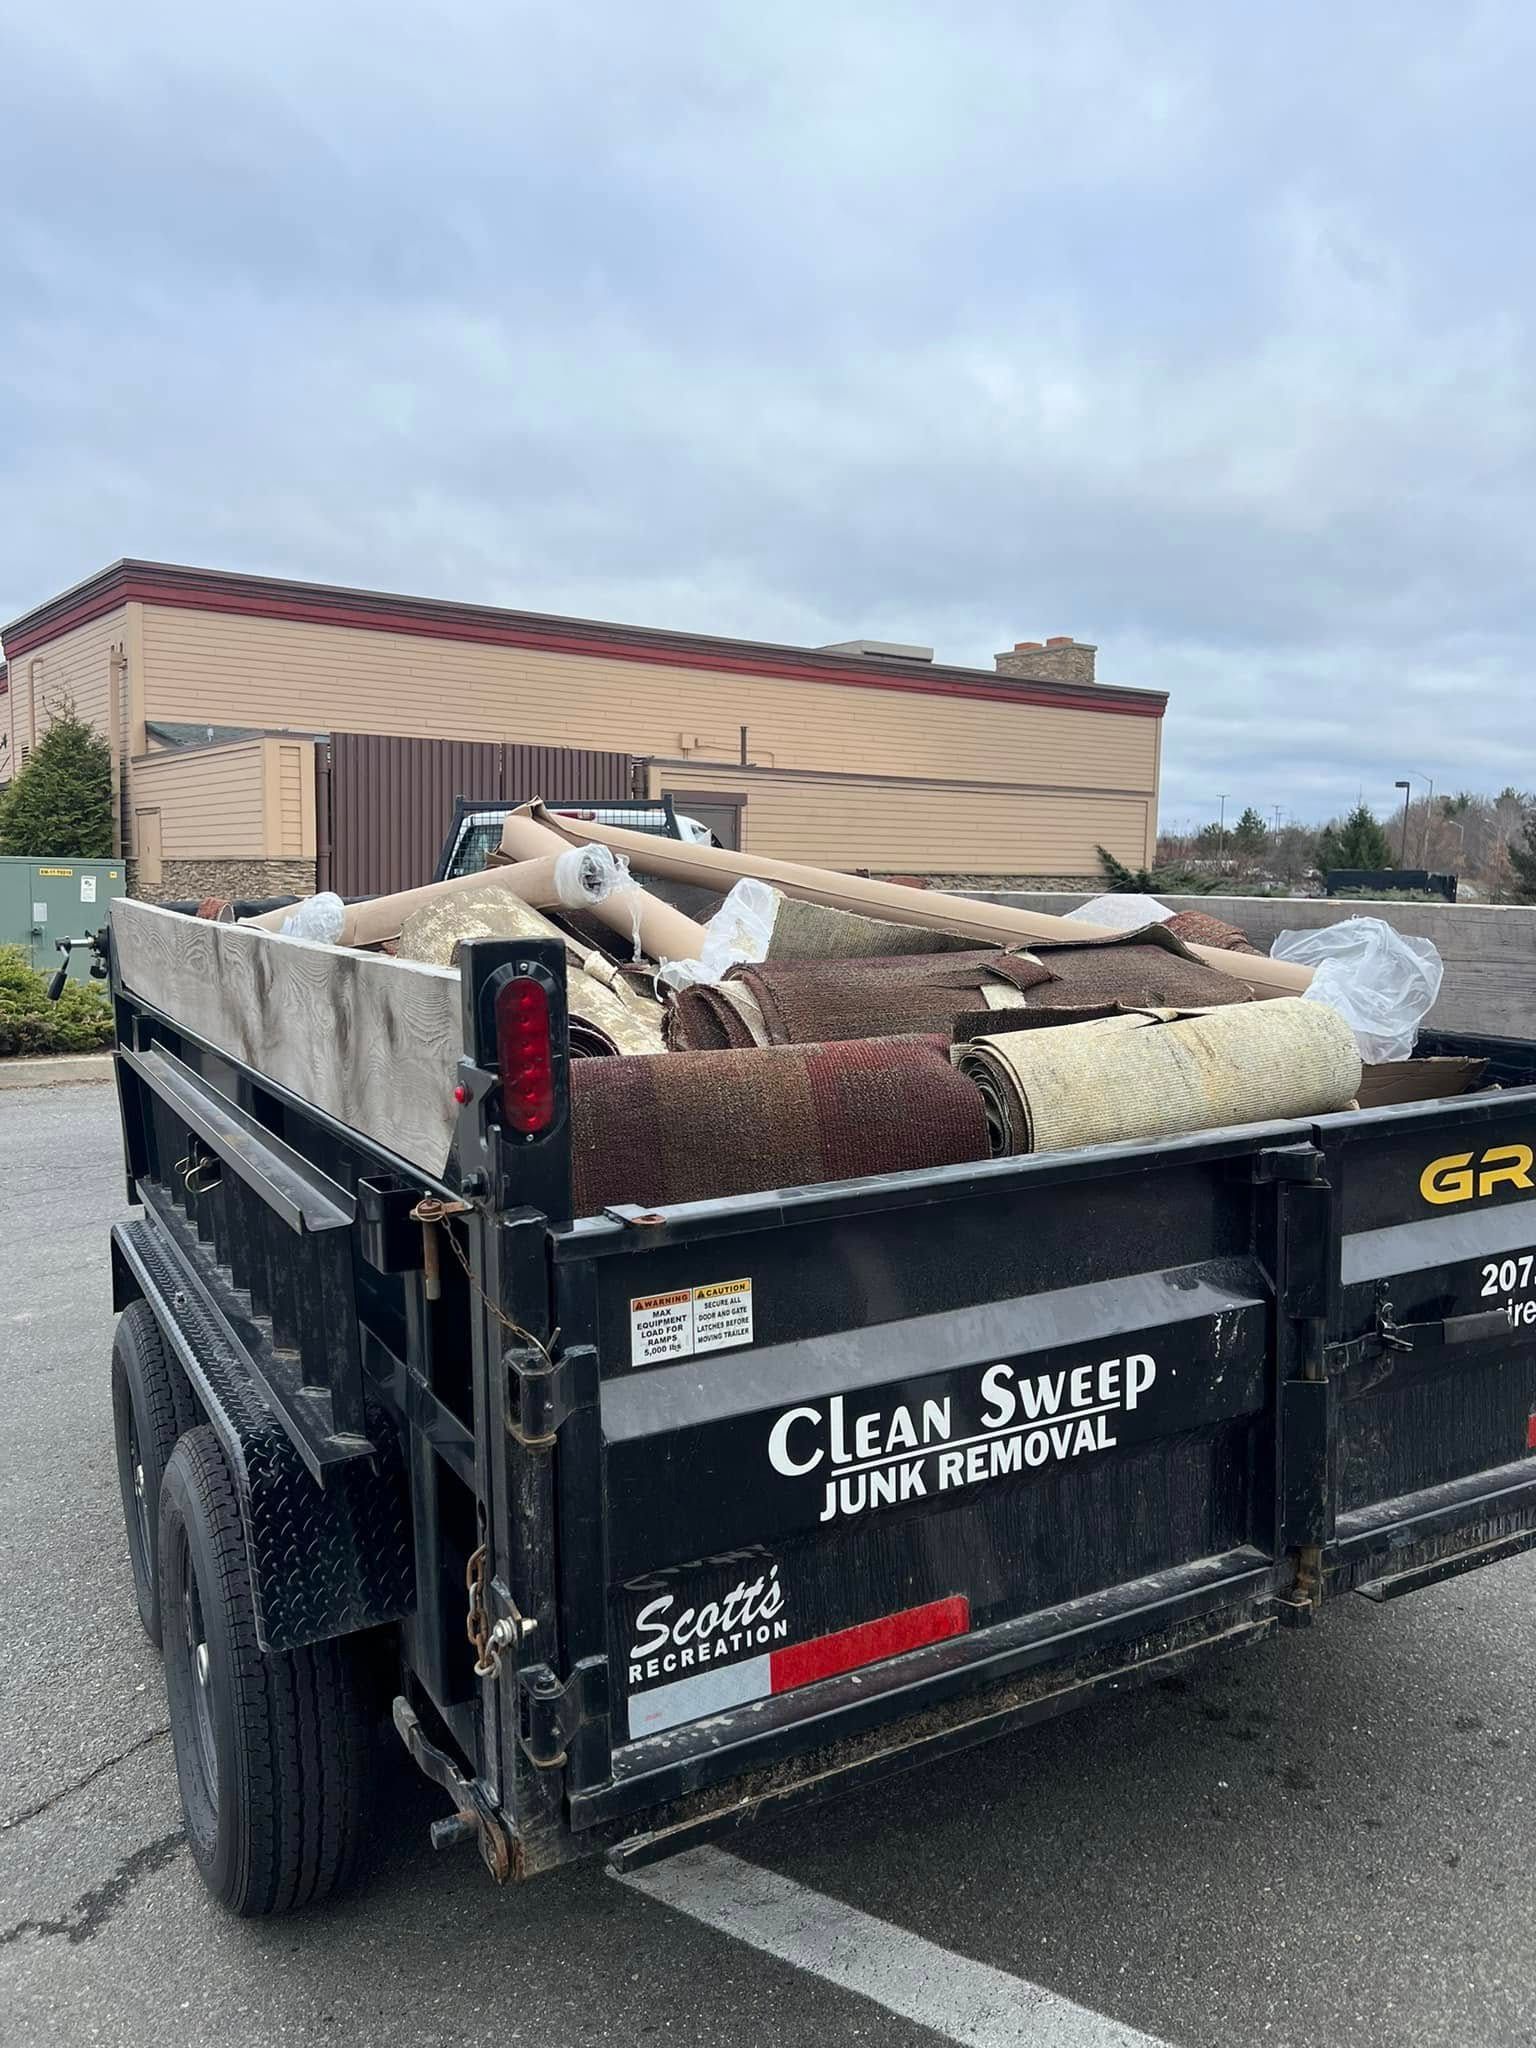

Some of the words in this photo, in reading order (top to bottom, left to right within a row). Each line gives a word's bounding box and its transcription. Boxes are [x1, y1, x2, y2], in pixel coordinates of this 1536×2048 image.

[1481, 1255, 1536, 1297] 207
[706, 1283, 745, 1297] CAUTION
[644, 1294, 688, 1308] WARNING
[704, 1299, 728, 1309] SECURE
[730, 1297, 741, 1305] ALL
[653, 1308, 671, 1318] MAX
[698, 1312, 716, 1321] DOOR
[718, 1309, 730, 1317] AND
[731, 1306, 747, 1315] GATE
[637, 1314, 687, 1330] EQUIPMENT
[697, 1321, 724, 1333] LATCHES
[726, 1316, 749, 1327] BEFORE
[641, 1328, 664, 1338] LOAD
[666, 1324, 683, 1334] FOR
[698, 1333, 723, 1343] MOVING
[724, 1328, 749, 1338] TRAILER
[648, 1335, 677, 1346] RAMPS
[644, 1345, 667, 1356] 5,000
[670, 1343, 681, 1352] lbs
[820, 1460, 927, 1522] JUNK
[939, 1416, 1117, 1491] REMOVAL
[630, 1565, 784, 1659] Scott's
[628, 1619, 788, 1684] RECREATION
